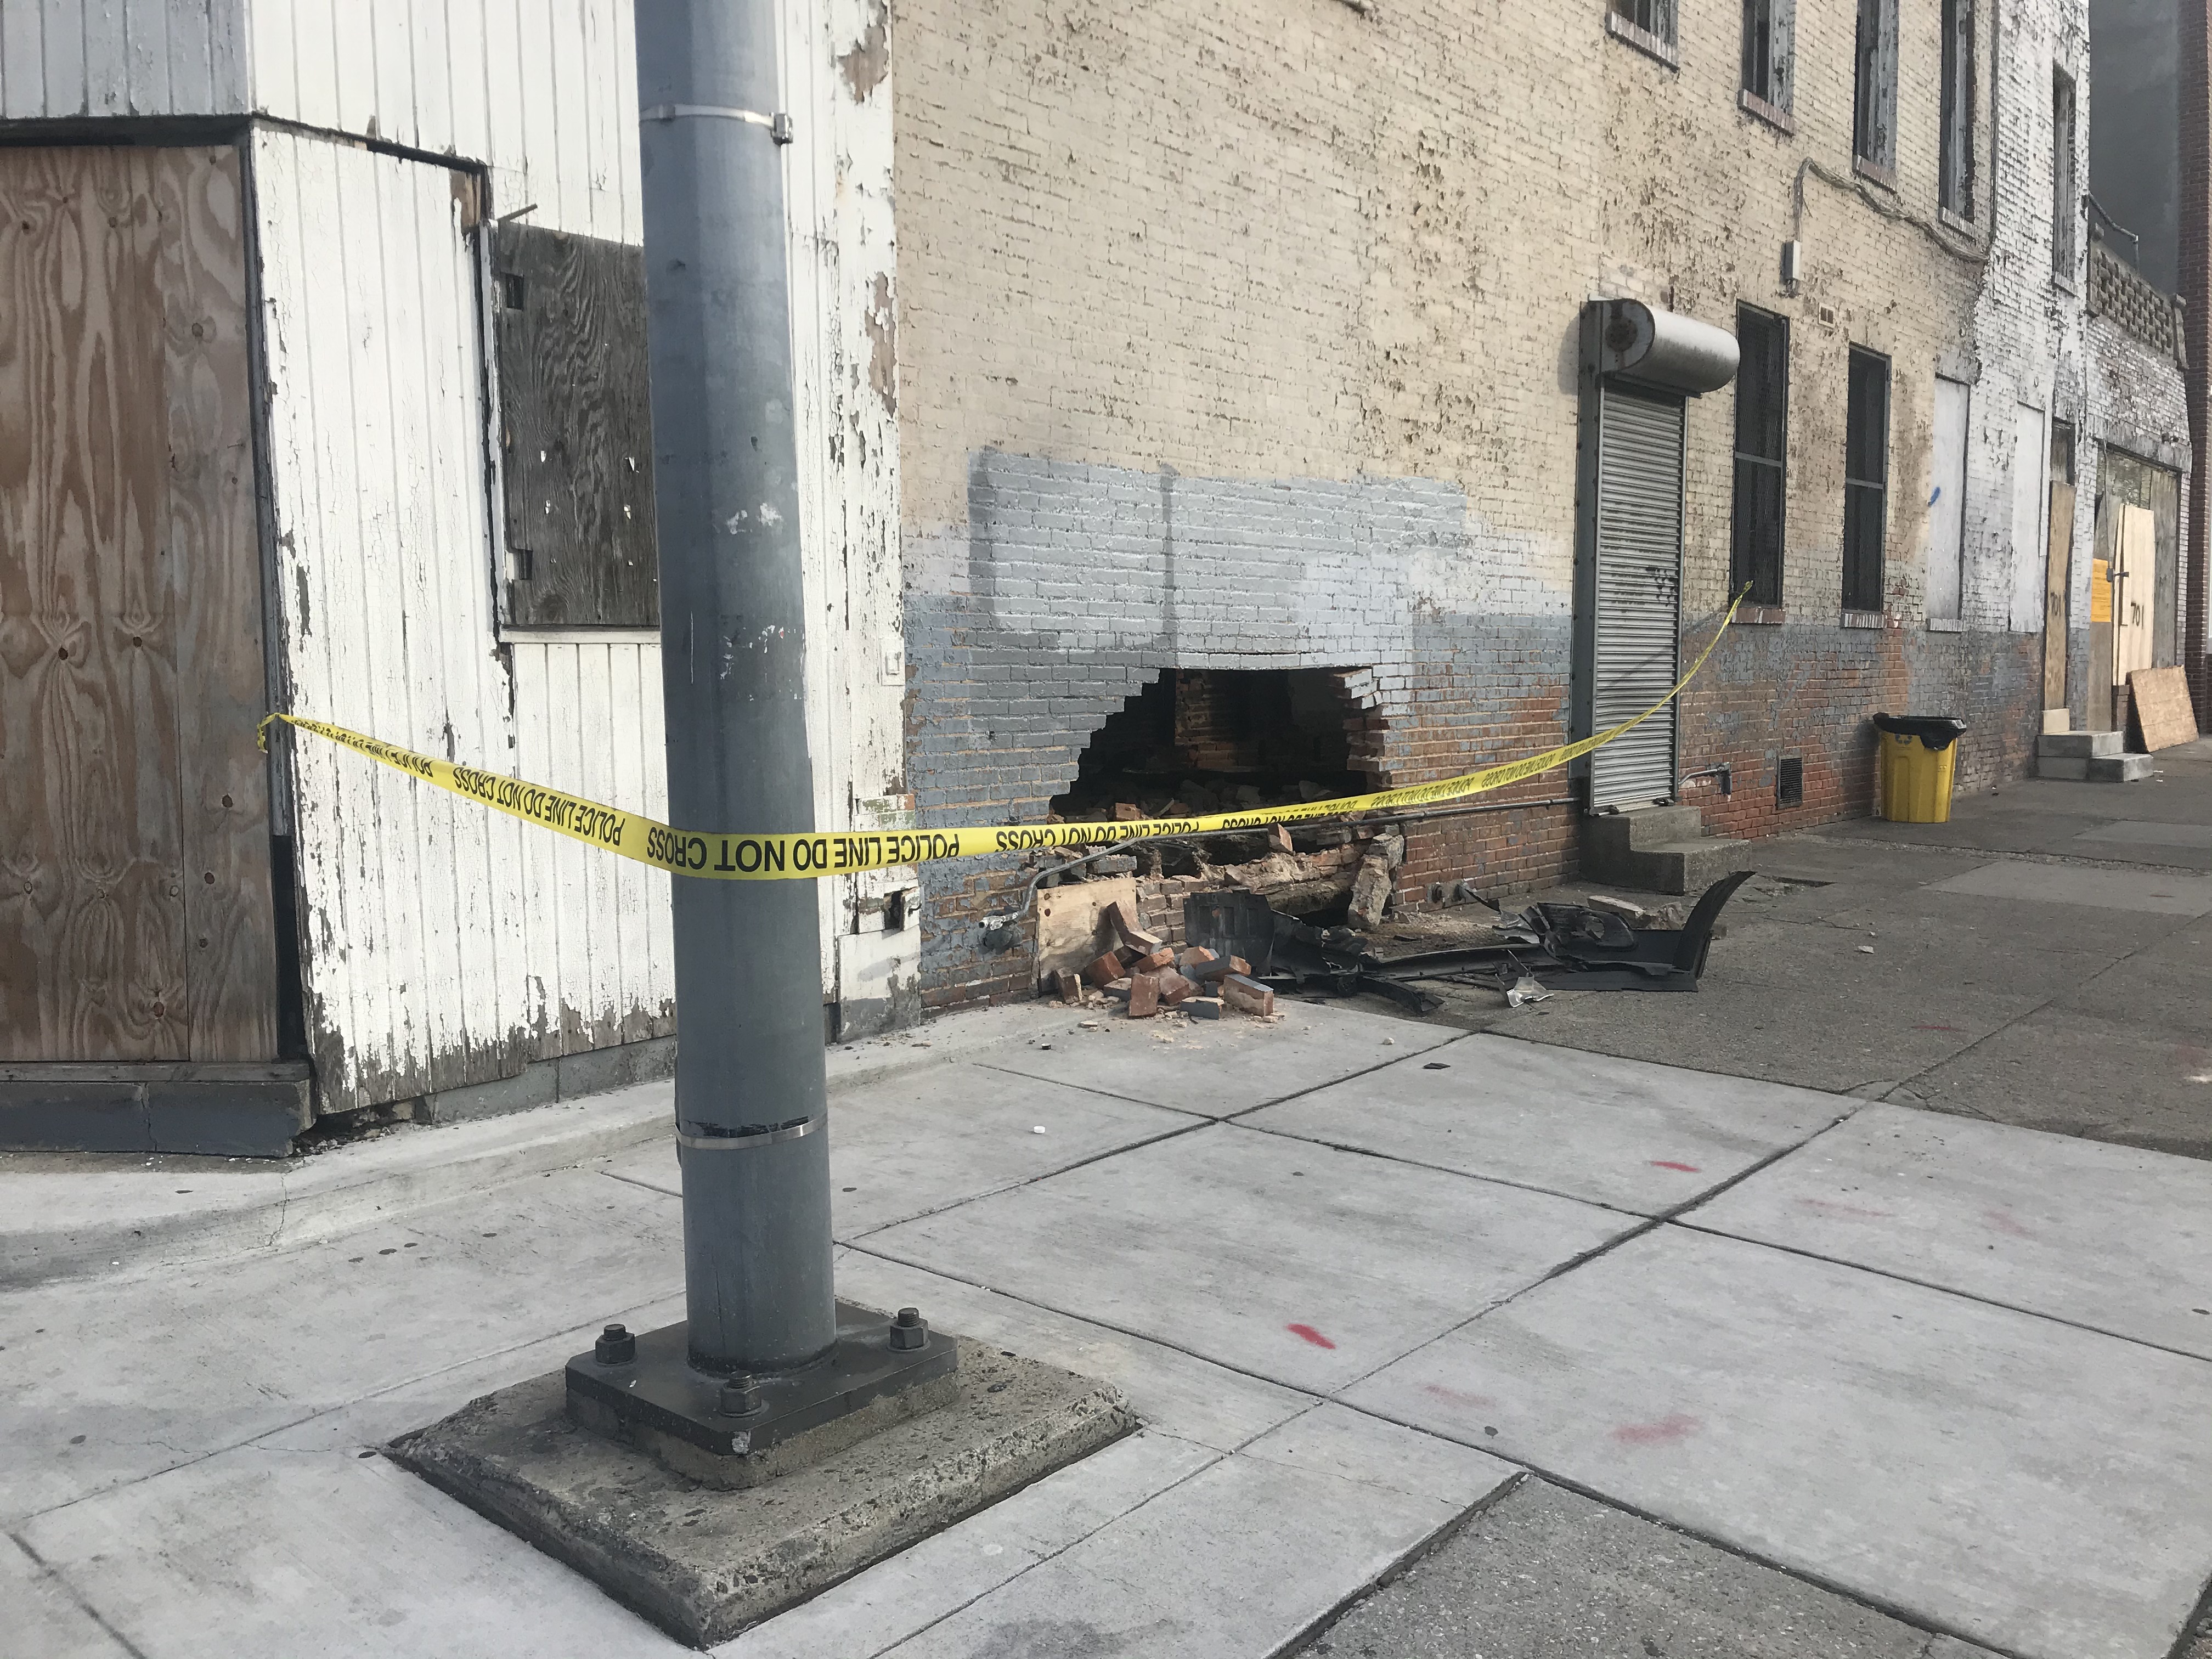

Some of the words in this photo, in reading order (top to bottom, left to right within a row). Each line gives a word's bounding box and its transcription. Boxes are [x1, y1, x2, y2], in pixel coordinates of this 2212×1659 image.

[2050, 592, 2061, 619] 701
[2131, 602, 2144, 630] 701
[453, 766, 496, 800] CROSS
[496, 780, 525, 811] NOT
[523, 788, 546, 818] DO
[544, 795, 577, 829] LINE
[574, 805, 625, 846] POLICE
[994, 828, 1056, 853] CROSS
[647, 827, 707, 870] CROSS
[714, 839, 785, 872] NOT
[793, 839, 827, 871] DO
[833, 837, 881, 868] LINE
[887, 834, 960, 864] POLICE
